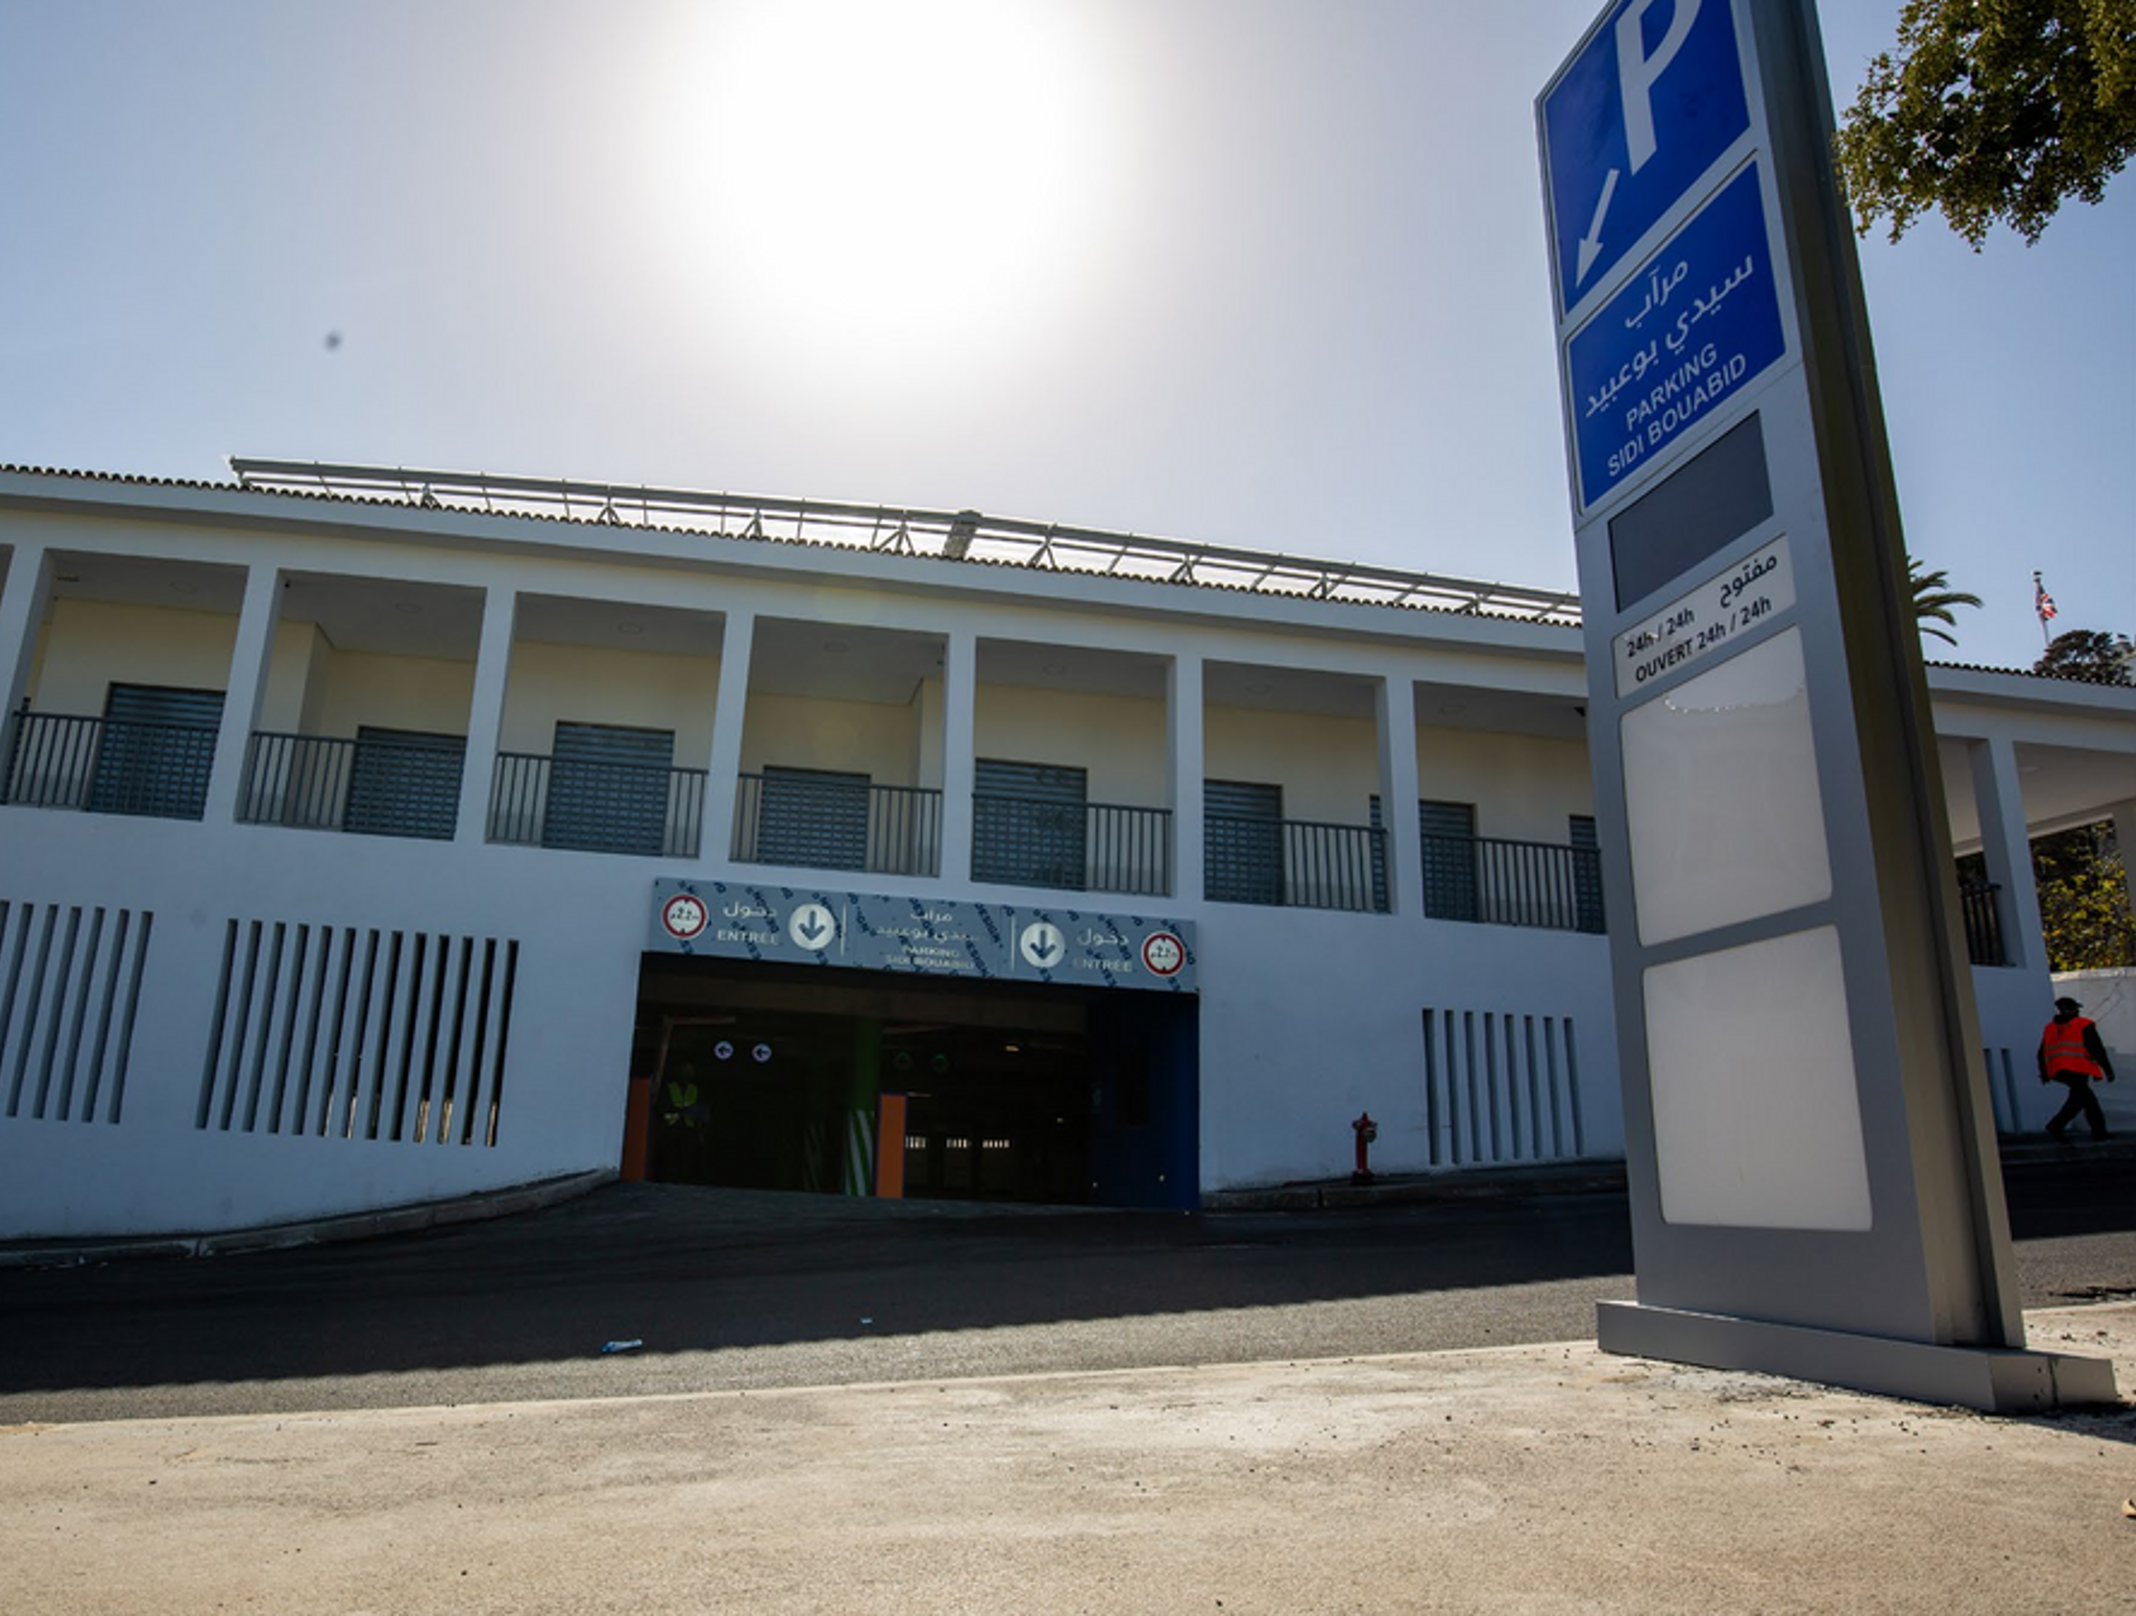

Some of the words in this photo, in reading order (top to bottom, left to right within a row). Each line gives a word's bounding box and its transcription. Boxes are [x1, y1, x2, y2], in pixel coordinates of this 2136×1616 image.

[1614, 0, 1702, 177] P
[1625, 260, 1688, 328] مرآب
[1665, 254, 1754, 355] سيدي
[1585, 339, 1660, 419] بوعبيد
[1607, 434, 1645, 478] SIDI
[1647, 352, 1747, 446] BOUABID
[1625, 342, 1718, 432] PARKING
[1666, 606, 1696, 636] 24h
[1719, 554, 1778, 609] مفتوح
[1626, 629, 1654, 658] 24h
[1635, 637, 1693, 683] OUVERT
[1696, 620, 1727, 651] 24h
[1739, 595, 1773, 627] 24h
